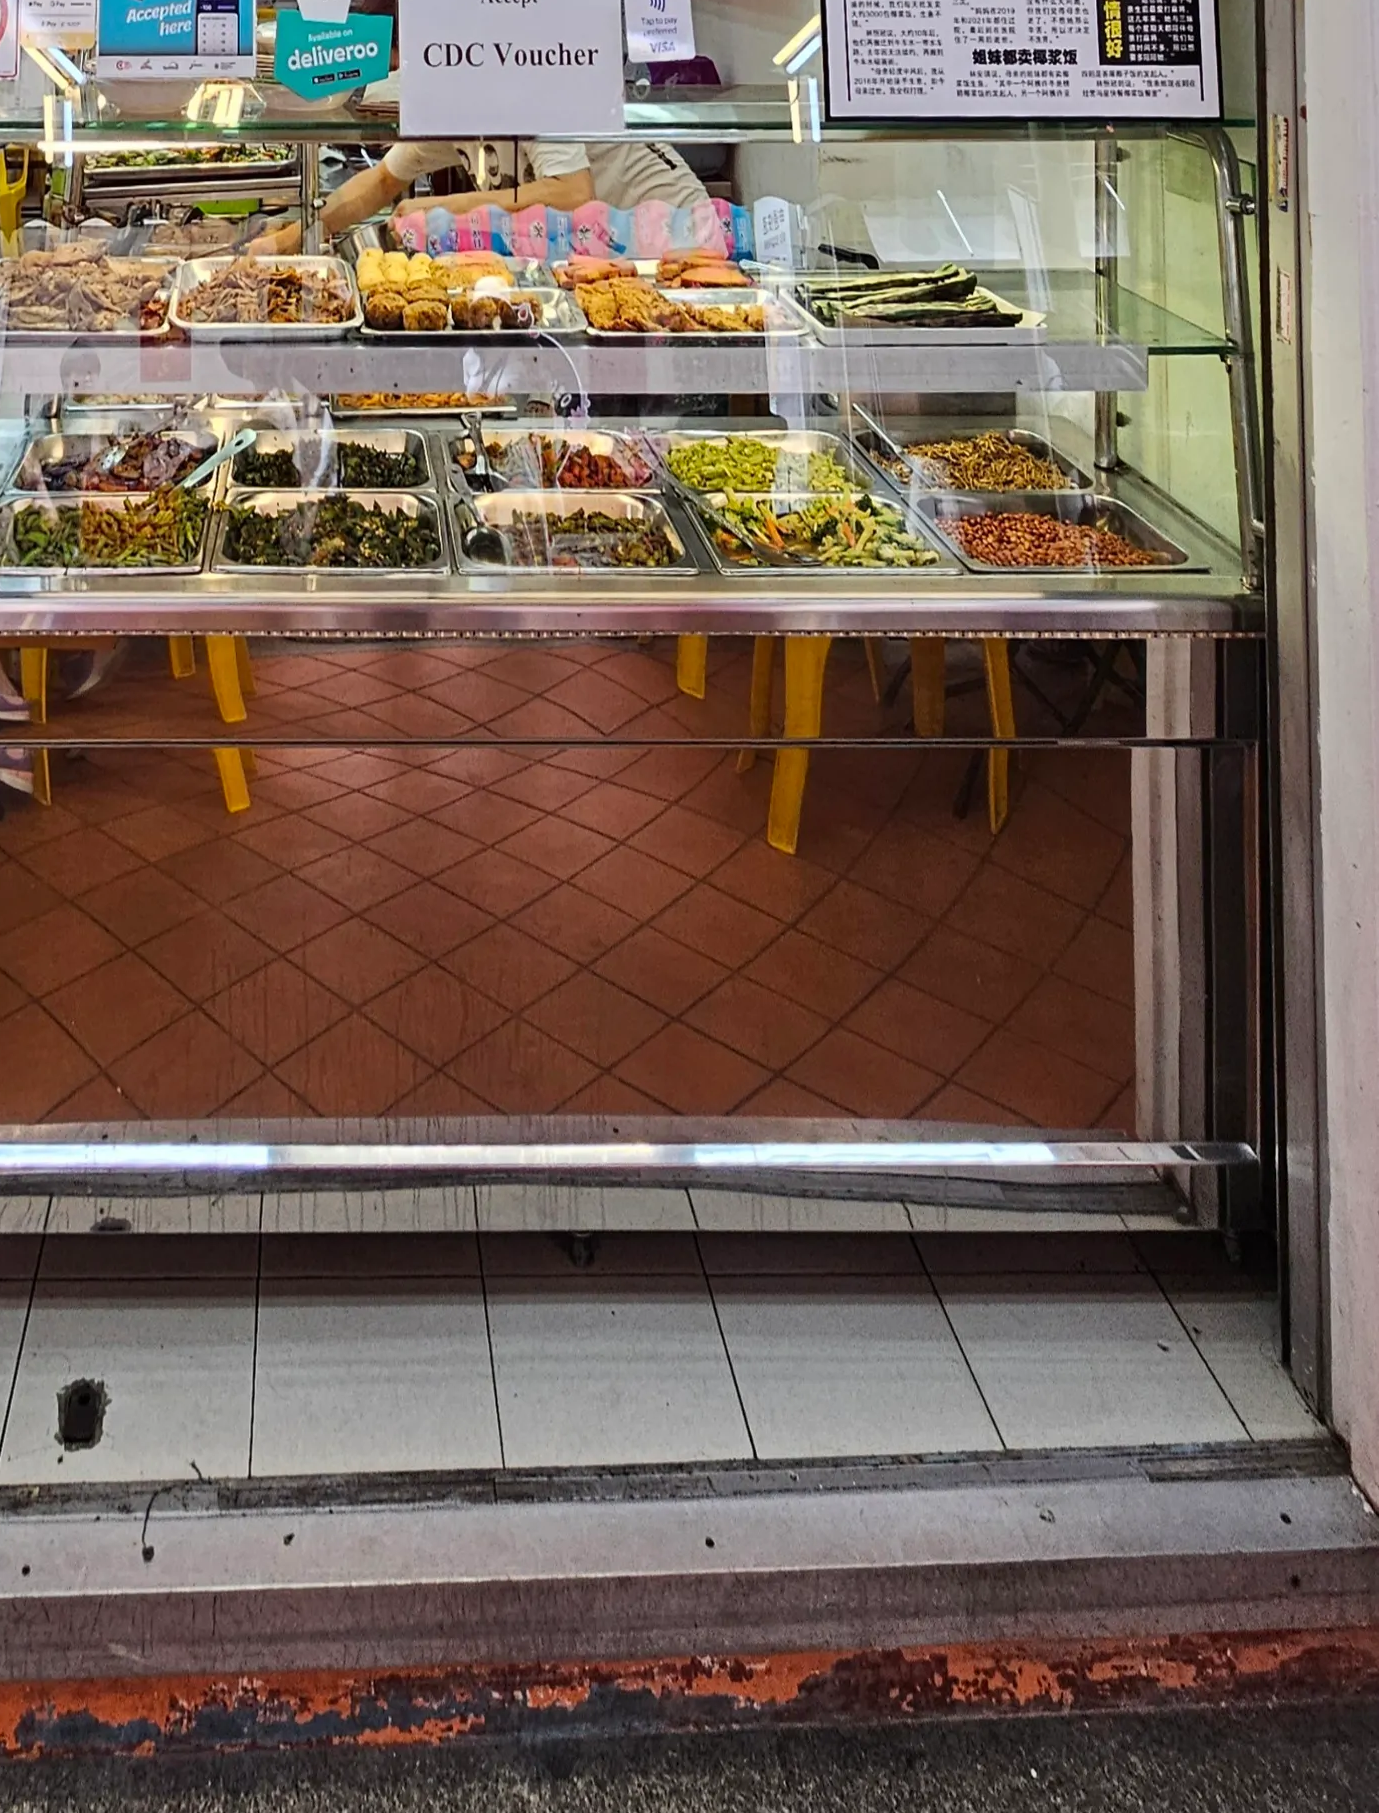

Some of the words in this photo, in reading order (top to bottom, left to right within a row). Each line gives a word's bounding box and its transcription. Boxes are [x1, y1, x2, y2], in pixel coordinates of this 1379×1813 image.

[127, 0, 191, 23] Accepted
[159, 20, 191, 36] here
[641, 17, 654, 26] Tap
[656, 17, 663, 25] to
[665, 18, 677, 26] pay
[308, 31, 341, 42] Available
[423, 42, 484, 67] CDC
[494, 42, 599, 66] Voucher
[649, 41, 675, 53] VISA
[288, 42, 378, 70] deliveroo
[972, 48, 1078, 65] 姐妹都卖椰浆饭
